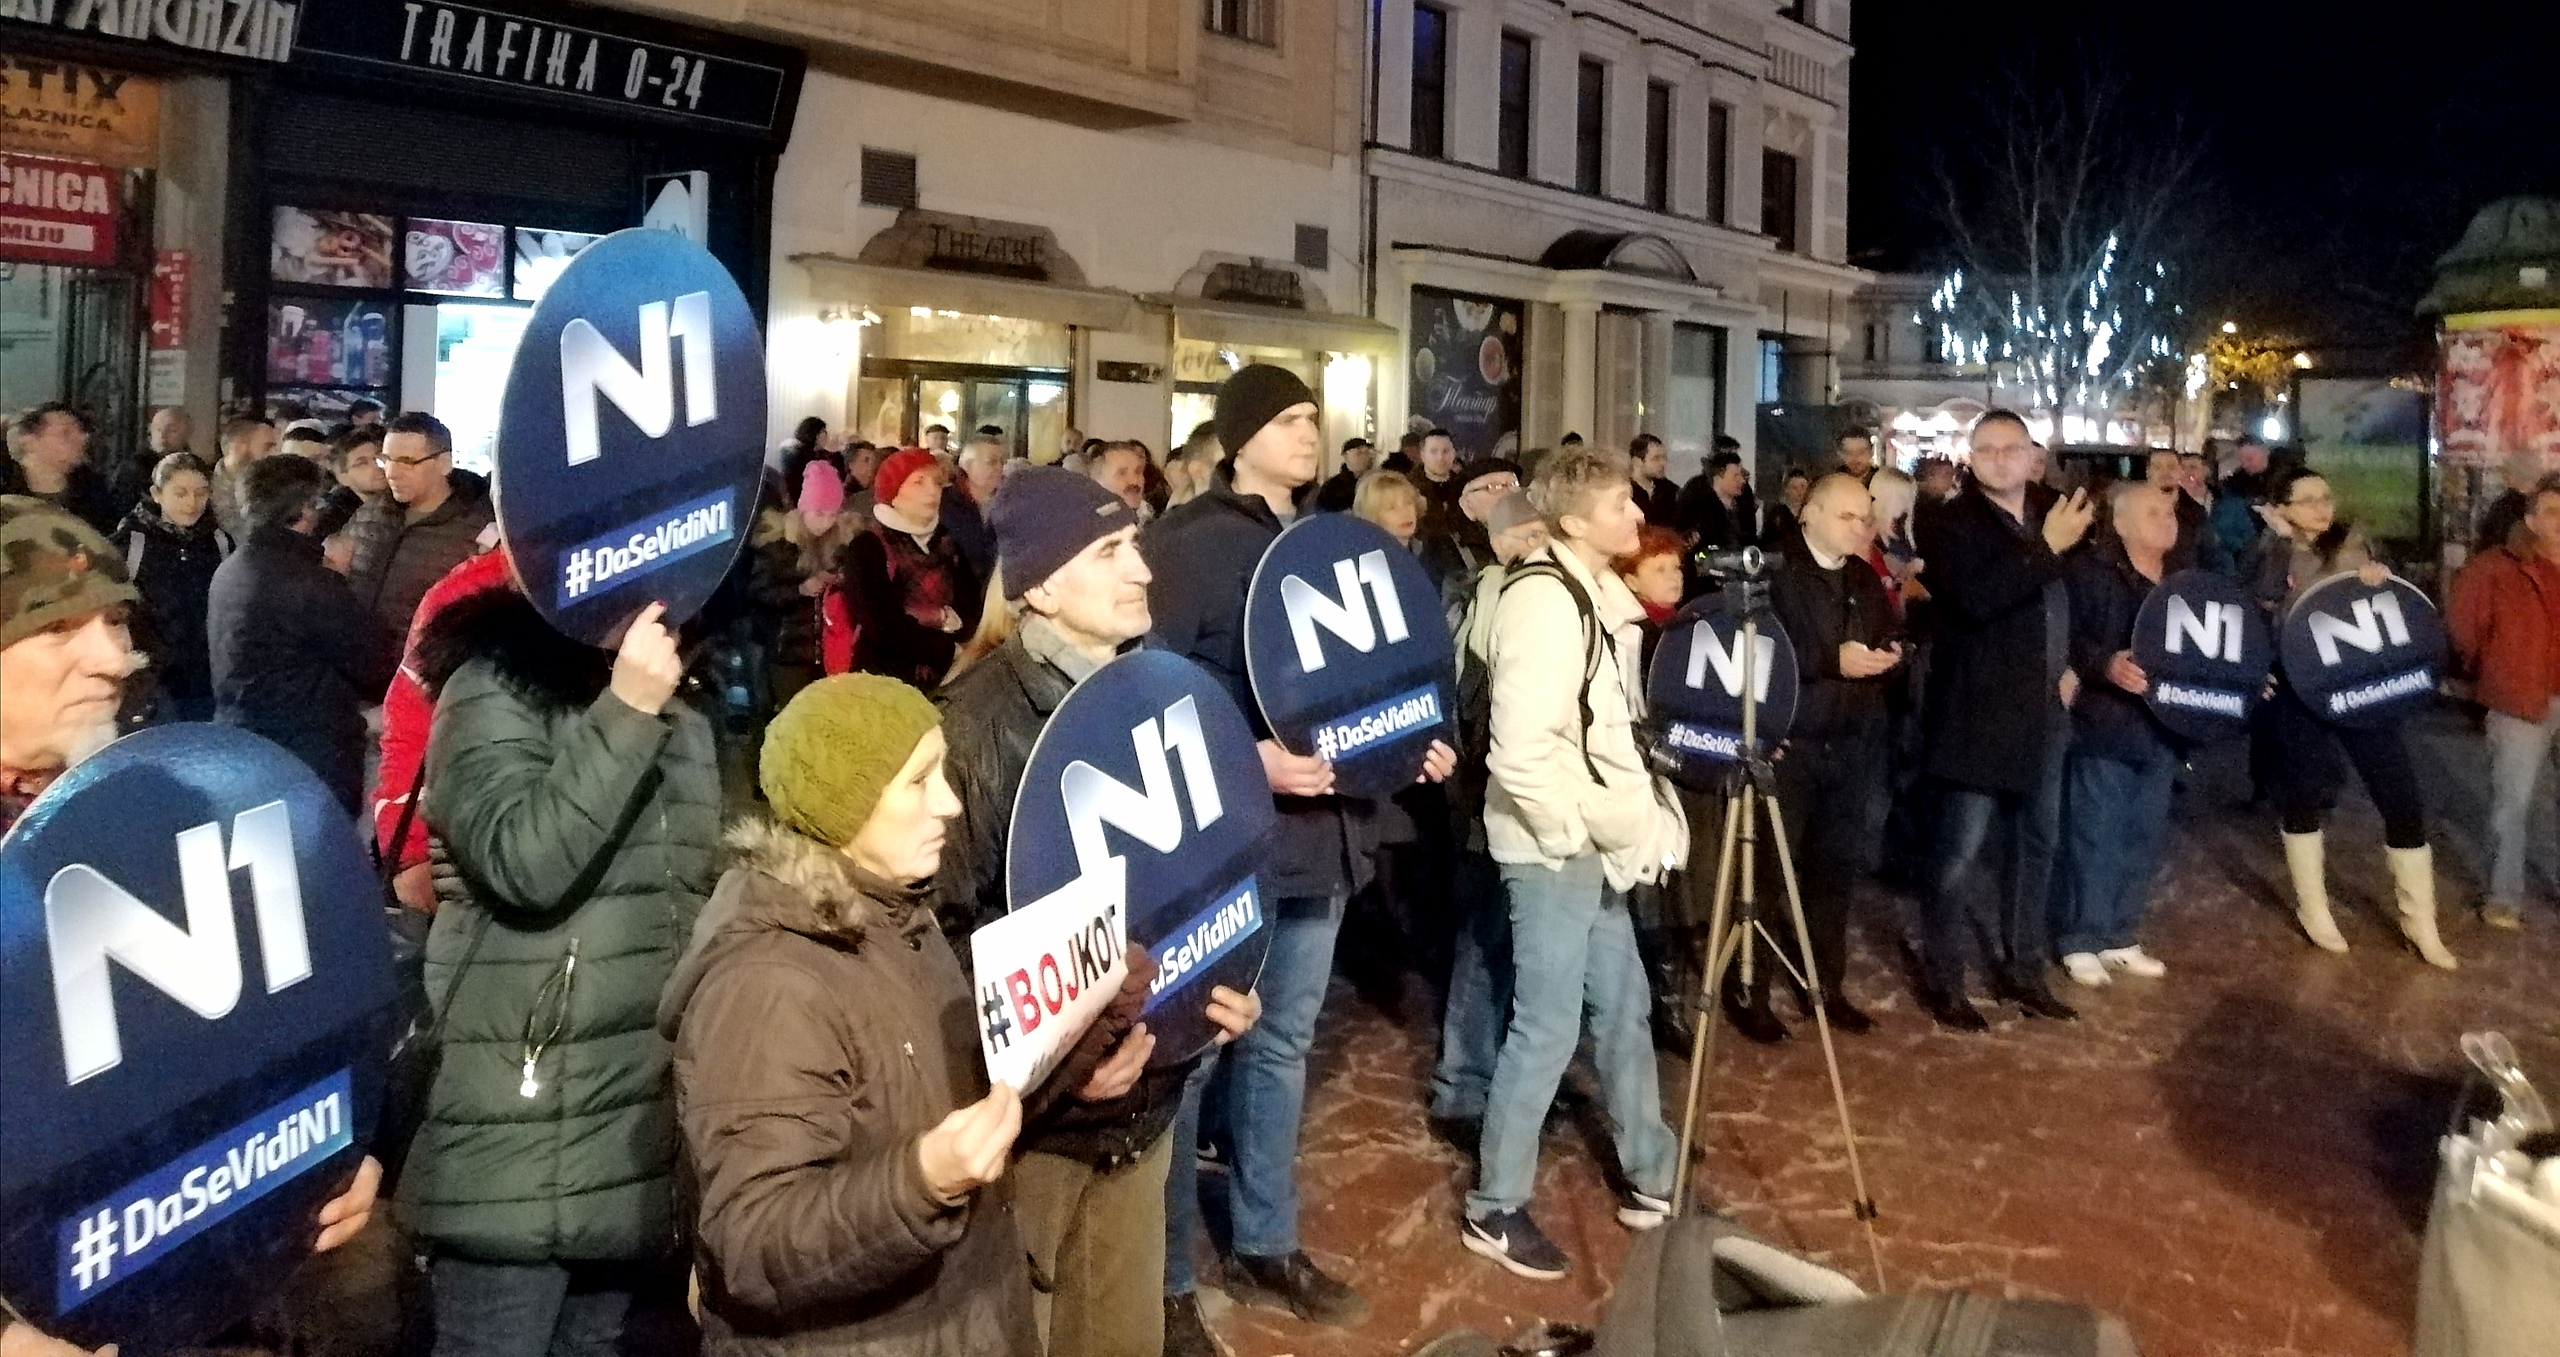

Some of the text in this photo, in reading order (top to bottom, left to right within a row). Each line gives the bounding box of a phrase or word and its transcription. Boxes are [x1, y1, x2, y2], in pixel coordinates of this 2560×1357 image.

[0, 56, 127, 117] TIX
[400, 2, 705, 110] TRAFIKA 0-24
[561, 291, 718, 466] N1
[564, 501, 728, 598] #DaSeVidiN1
[1280, 549, 1408, 673] N1
[1685, 619, 1775, 704] N1
[2165, 595, 2243, 662] N1
[2308, 591, 2411, 666] N1
[1317, 693, 1436, 761] #DaSeVidiN1
[1060, 694, 1224, 876] N1
[44, 800, 313, 1085] N1
[983, 904, 1122, 1054] #BOJKOT
[1150, 890, 1255, 995] aSeVidiN1
[70, 1092, 342, 1292] #DaSeVidiN1
